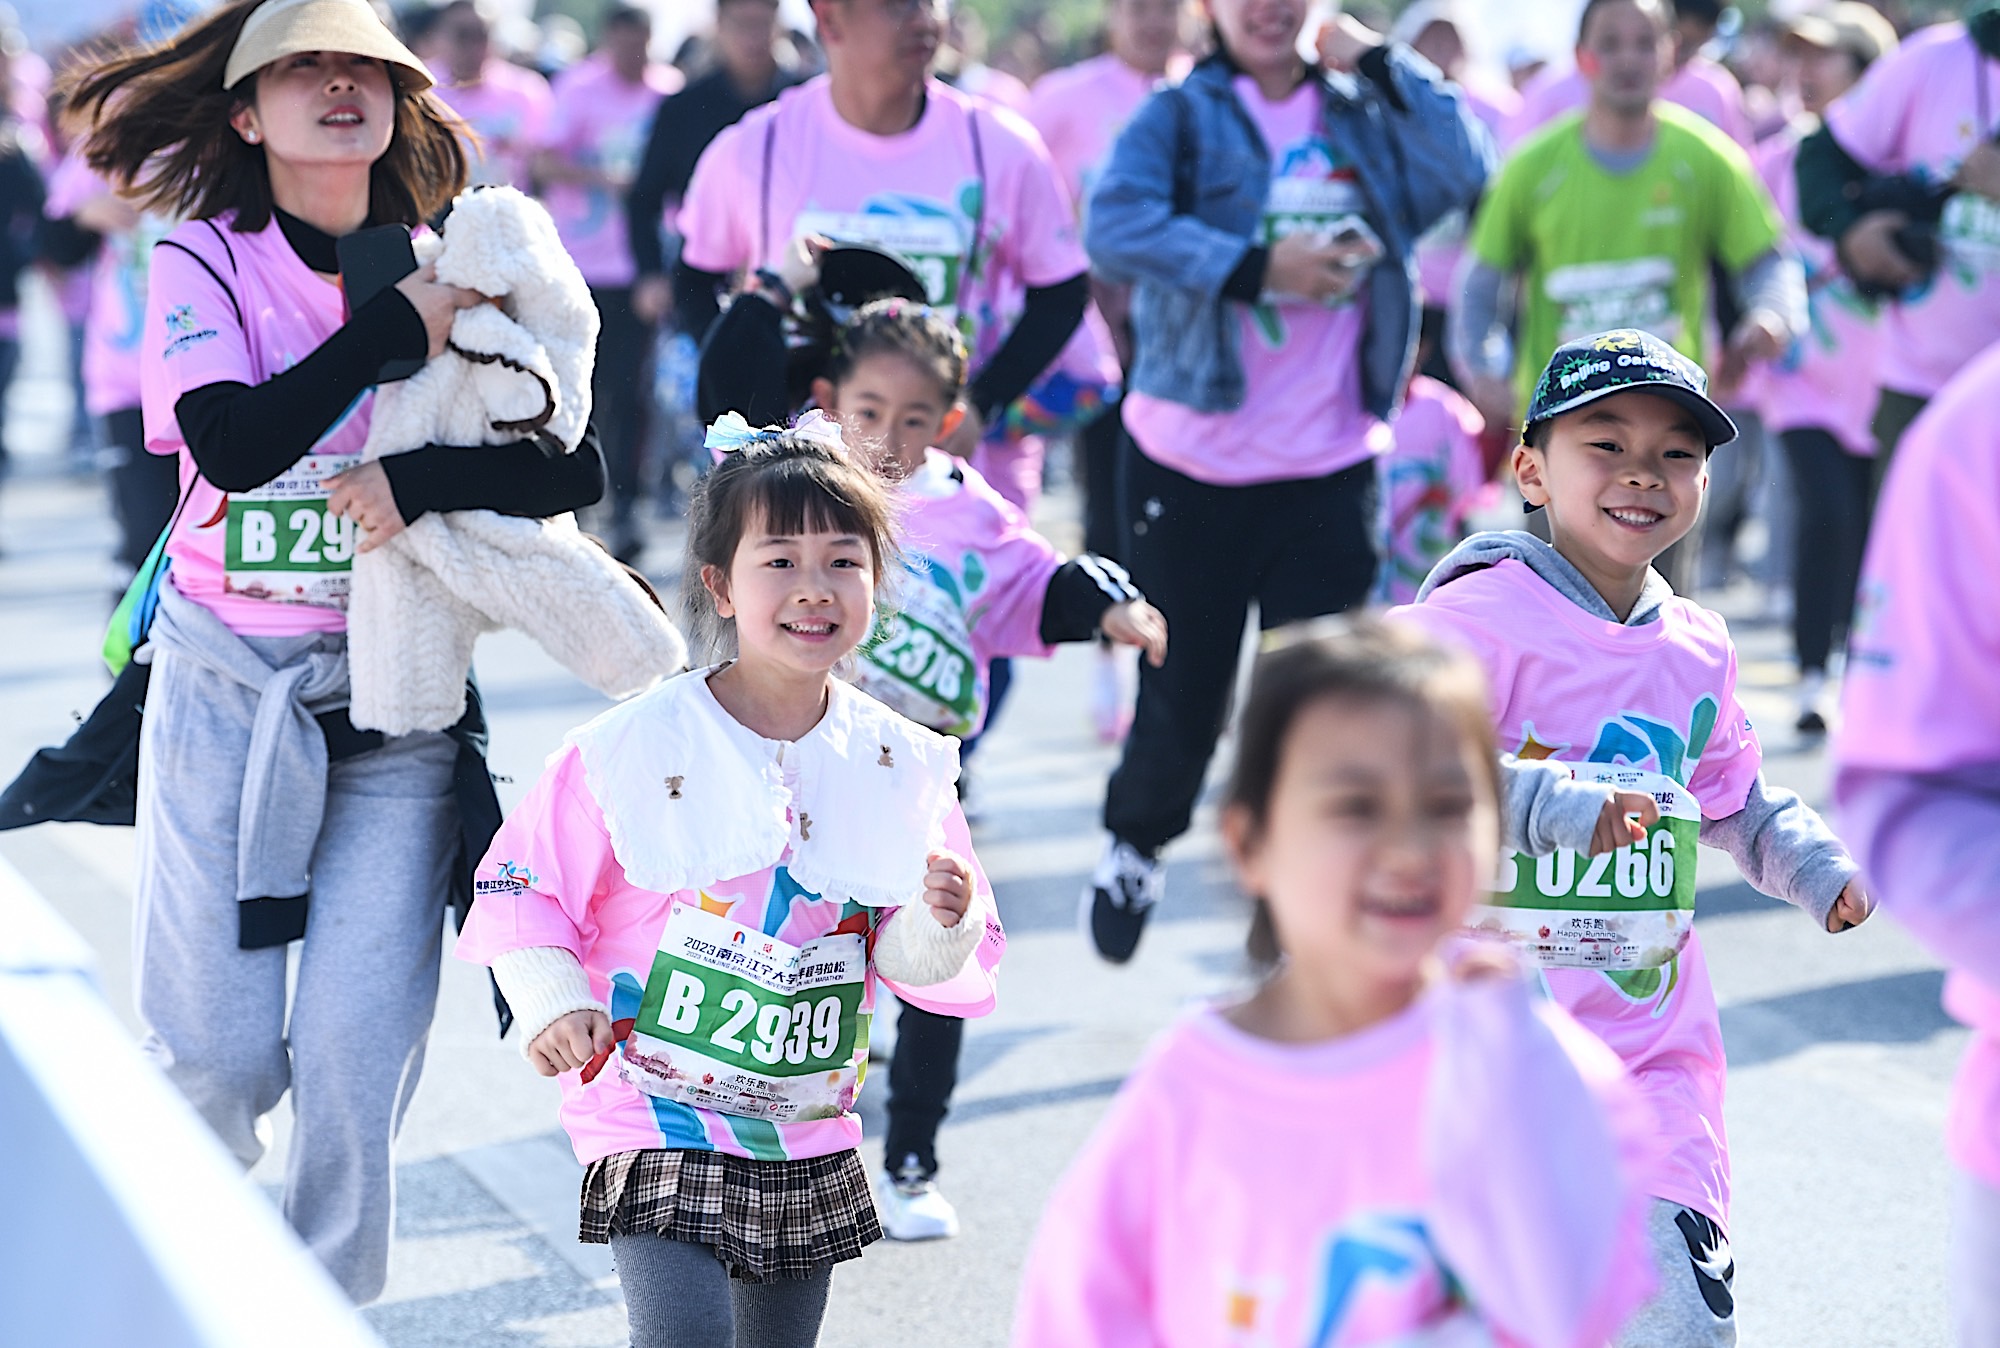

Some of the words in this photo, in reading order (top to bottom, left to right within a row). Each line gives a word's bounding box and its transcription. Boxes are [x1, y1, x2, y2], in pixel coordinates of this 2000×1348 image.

[1560, 359, 1611, 390] Beijing
[1617, 354, 1678, 375] Garden
[241, 509, 277, 563] B
[1535, 829, 1675, 898] 0266
[1557, 930, 1581, 938] Happy
[1571, 918, 1604, 929] 欢乐跑
[703, 956, 730, 968] NANJING
[815, 973, 844, 984] MARATHON
[657, 969, 706, 1034] B
[709, 989, 842, 1064] 2939
[720, 1080, 744, 1093] Happy
[745, 1086, 776, 1099] Running
[734, 1074, 768, 1089] 欢乐跑
